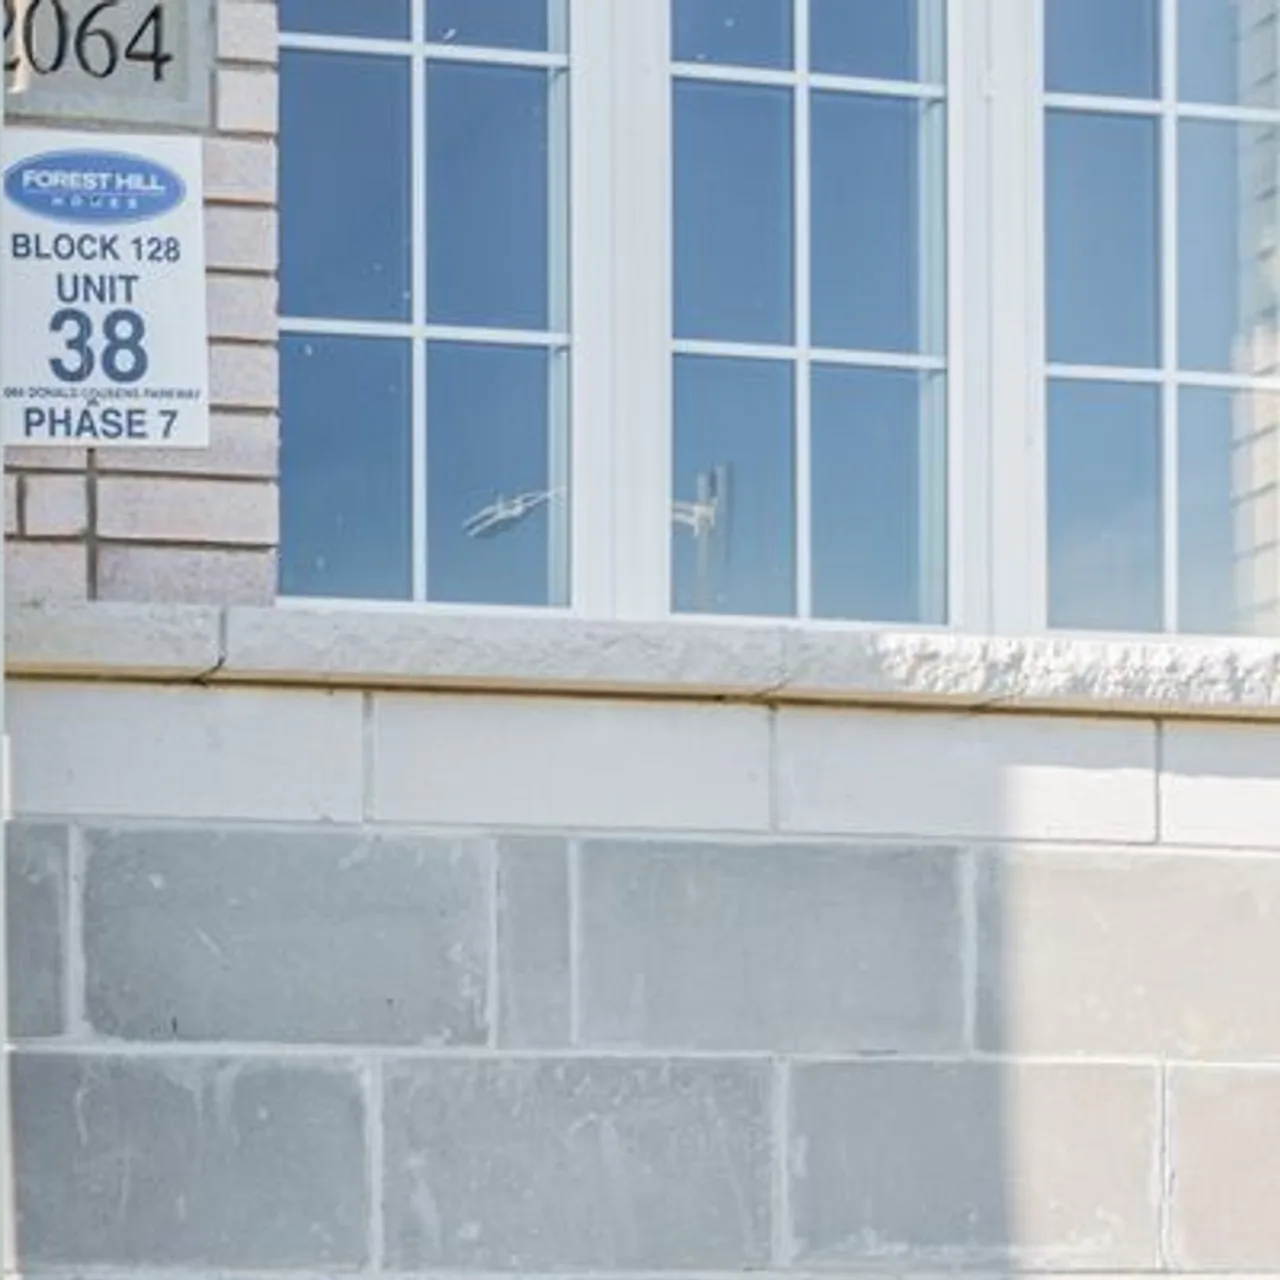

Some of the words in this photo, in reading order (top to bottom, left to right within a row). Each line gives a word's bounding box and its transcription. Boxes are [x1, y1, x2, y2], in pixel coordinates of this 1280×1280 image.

[21, 168, 113, 190] FOREST
[115, 171, 166, 191] HILL
[11, 233, 121, 261] BLOCK
[131, 236, 181, 263] 128
[56, 273, 139, 304] UNIT
[48, 307, 149, 383] 38
[24, 406, 149, 439] PHASE
[158, 409, 178, 439] 7
